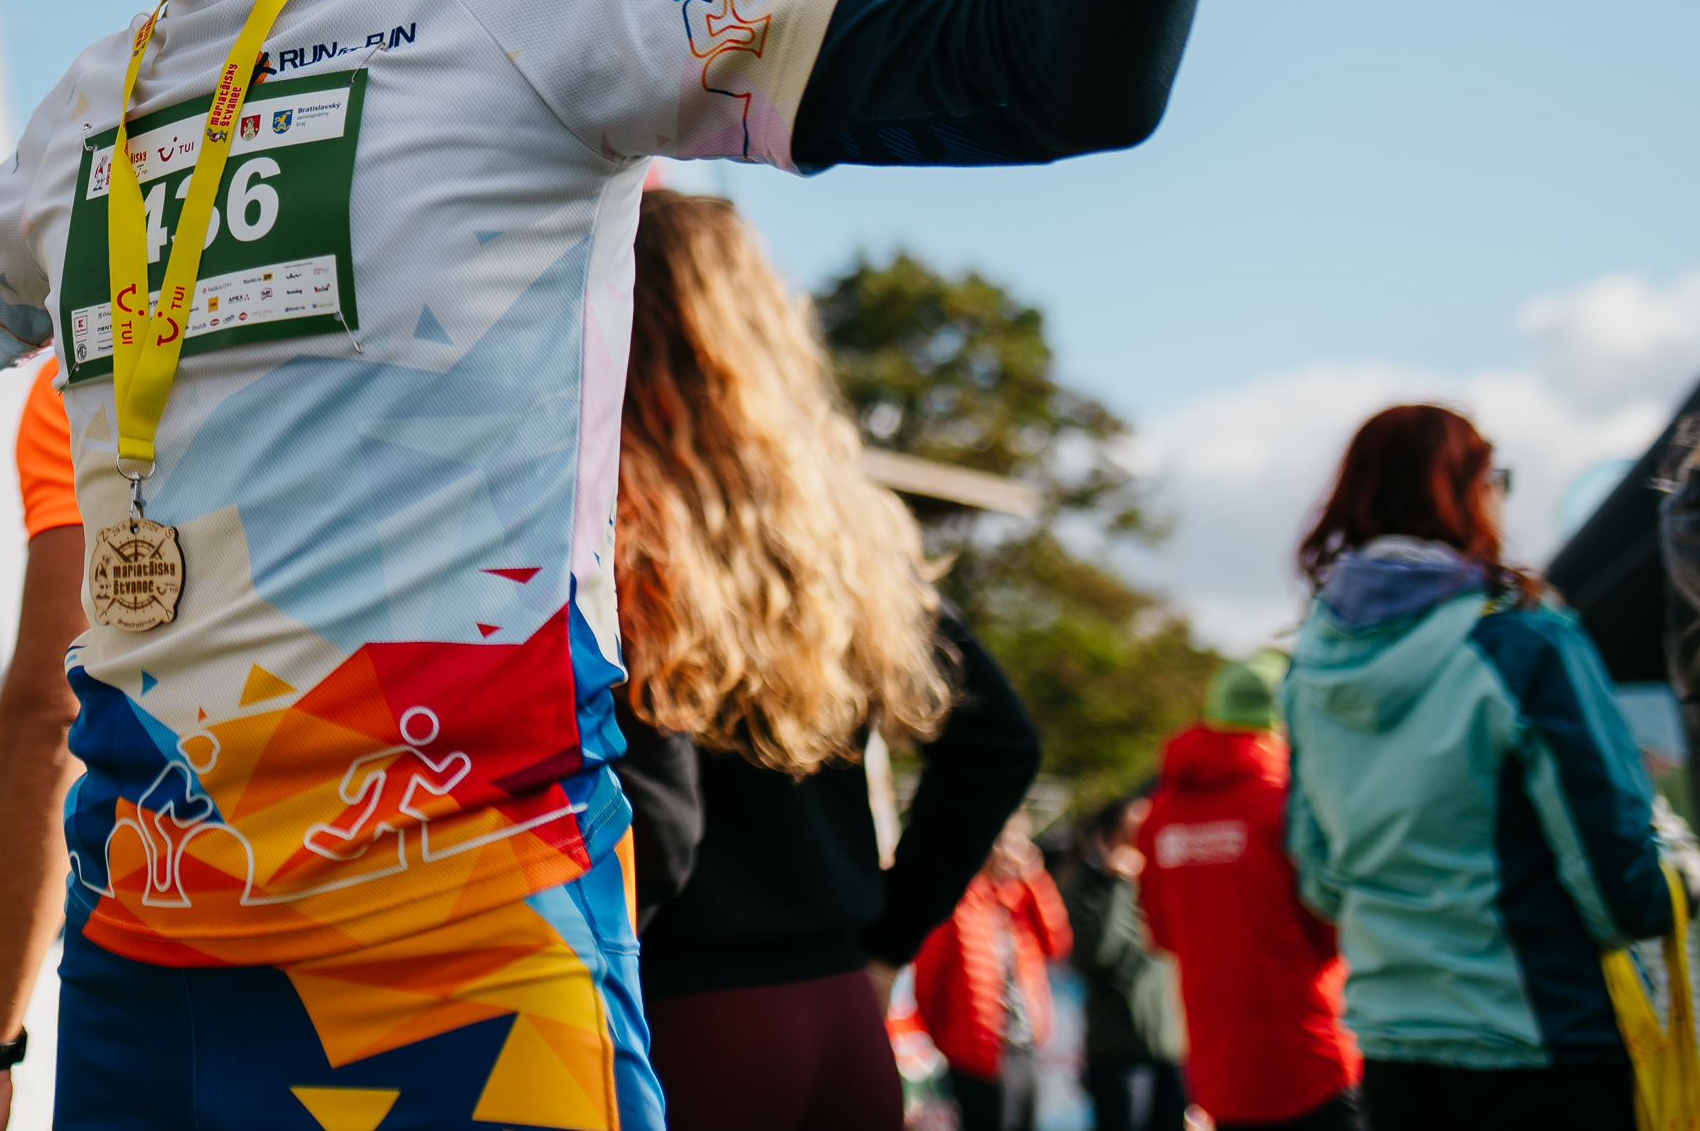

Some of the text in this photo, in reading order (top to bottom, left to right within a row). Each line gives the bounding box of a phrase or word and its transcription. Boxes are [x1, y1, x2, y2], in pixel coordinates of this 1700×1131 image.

[279, 41, 337, 72] RUN
[179, 142, 194, 154] TUI
[171, 286, 186, 310] TUI
[121, 320, 133, 344] TUI
